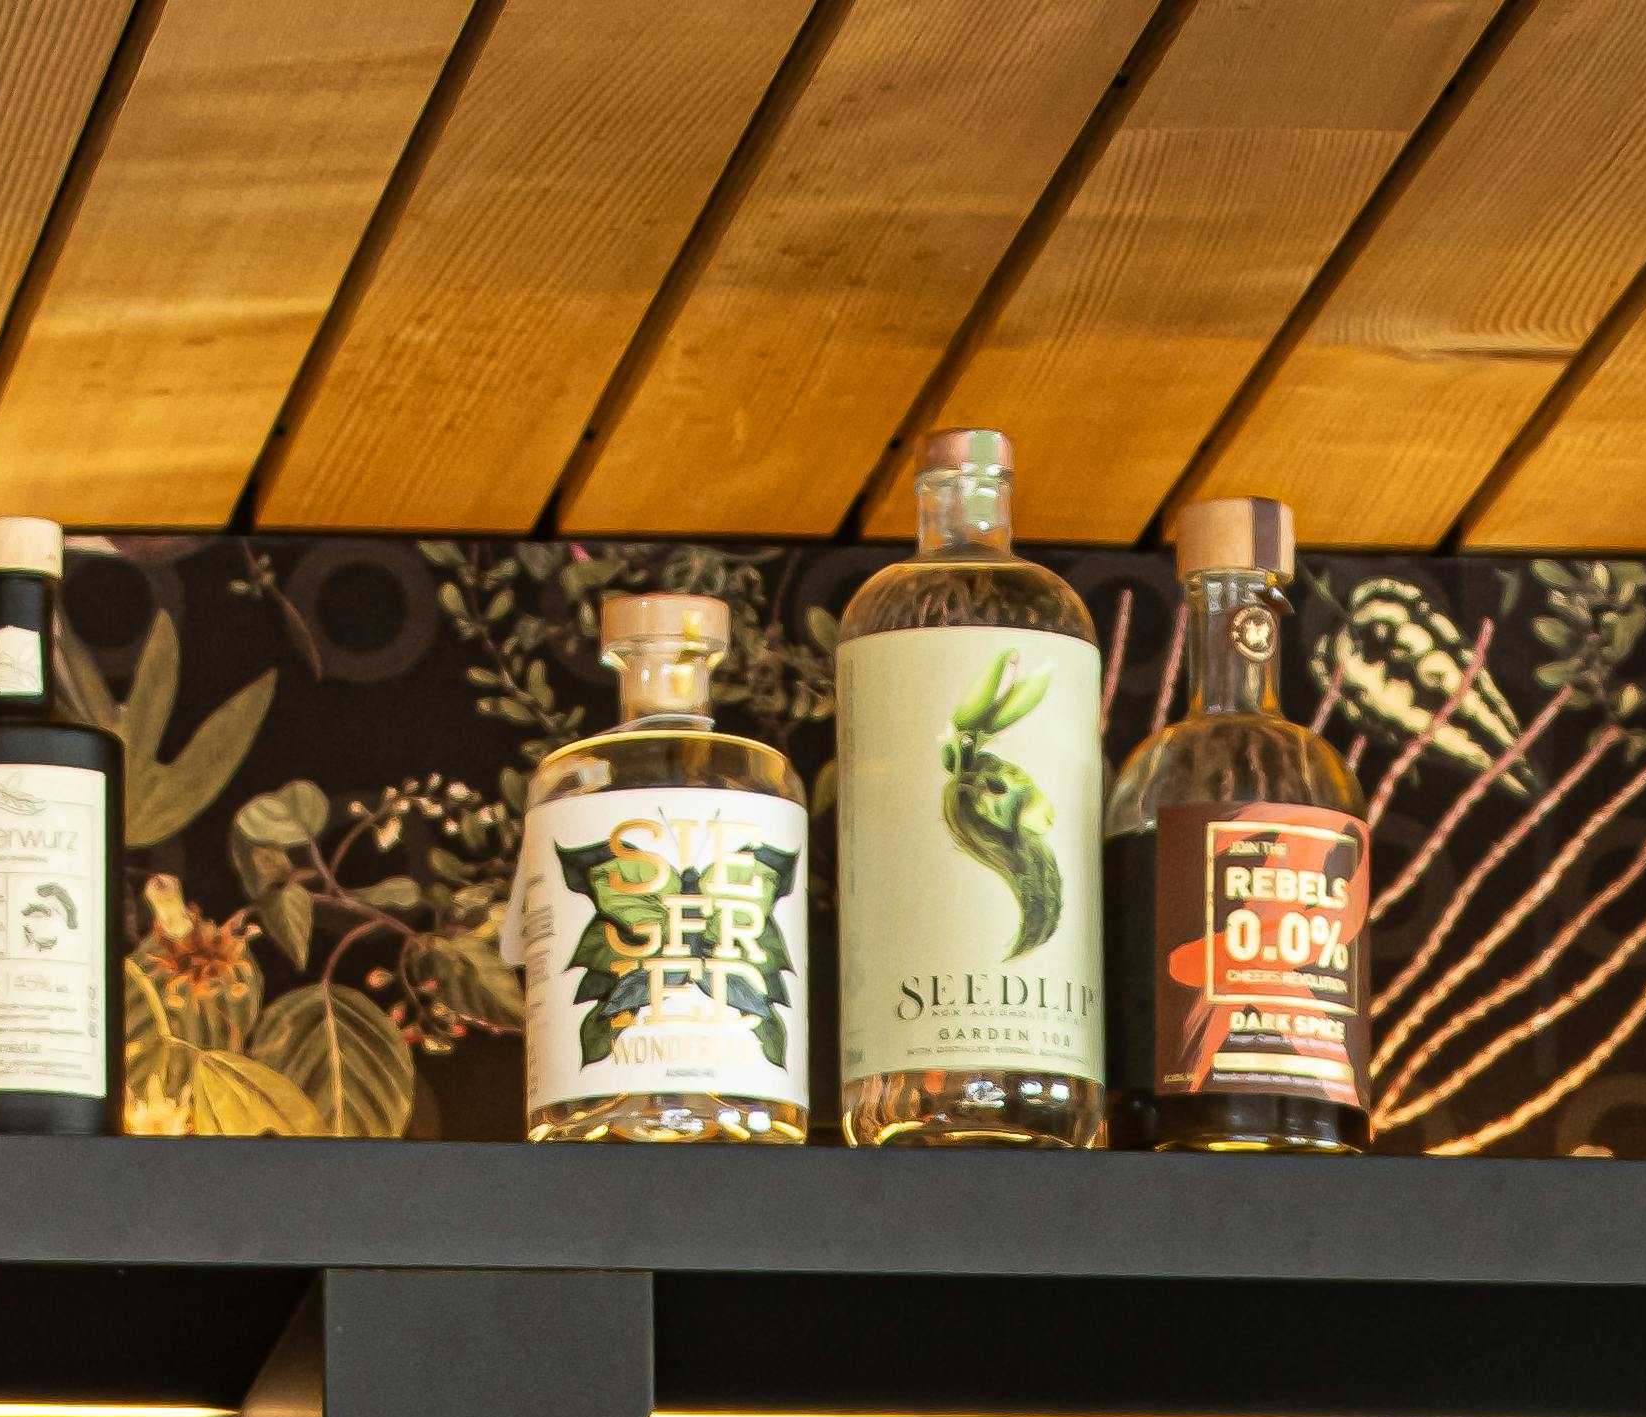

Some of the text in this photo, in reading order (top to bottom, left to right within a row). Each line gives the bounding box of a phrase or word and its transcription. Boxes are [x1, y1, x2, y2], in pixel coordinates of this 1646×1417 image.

[1225, 866, 1348, 908] REBELS
[1225, 909, 1349, 973] 0.0%
[897, 972, 1094, 1021] SEEDLIP
[937, 1028, 1030, 1042] GARDEN
[1230, 1011, 1347, 1041] DARK SPICE
